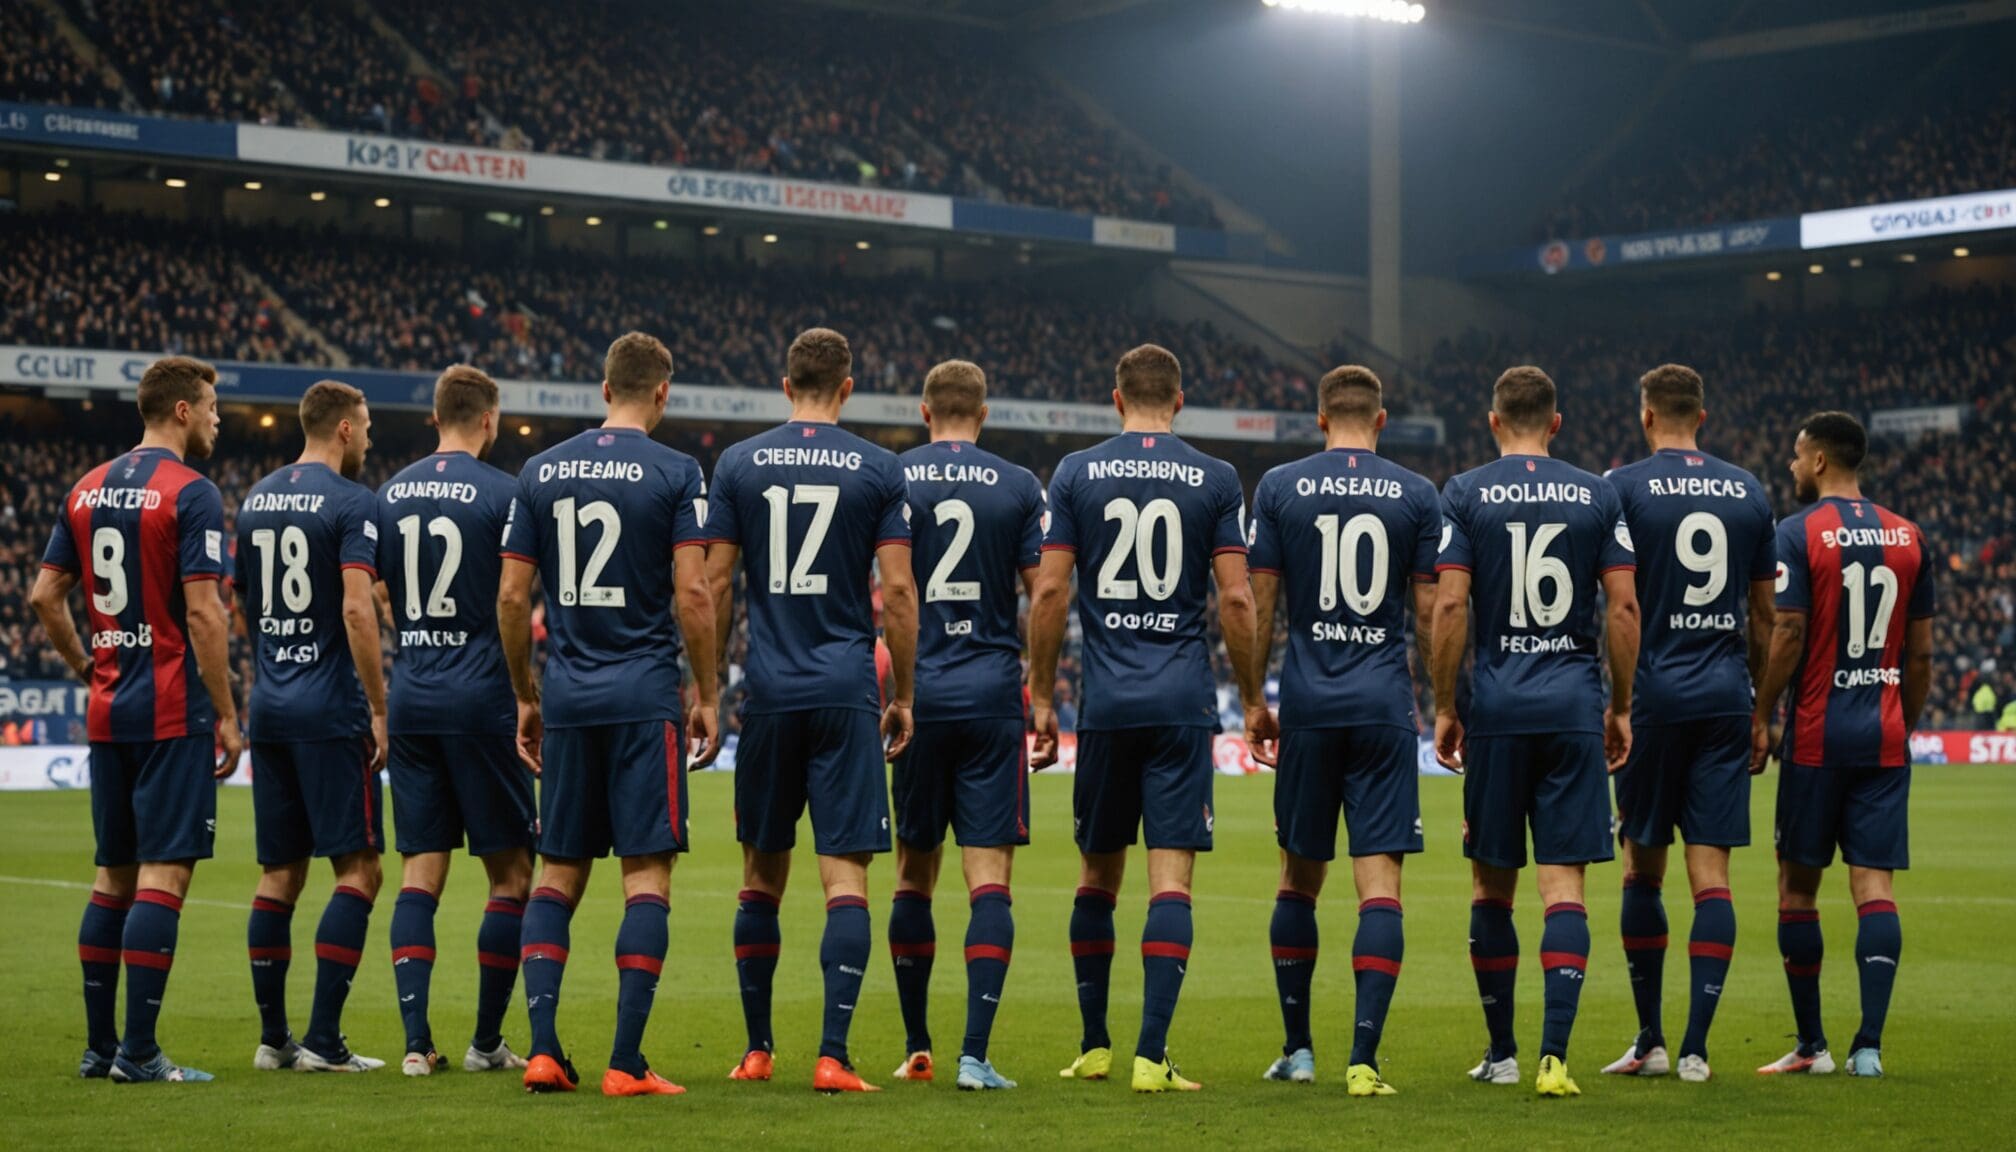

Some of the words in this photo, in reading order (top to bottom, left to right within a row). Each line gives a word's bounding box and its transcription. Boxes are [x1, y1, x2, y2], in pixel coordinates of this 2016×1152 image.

[92, 527, 128, 616] 9
[252, 525, 313, 616] 18
[397, 514, 463, 621] 12
[553, 497, 626, 607] 12
[926, 499, 981, 603] 2
[1097, 498, 1183, 601] 20
[1314, 513, 1389, 616] 10
[1506, 522, 1573, 628] 16
[1675, 512, 1728, 606] 9
